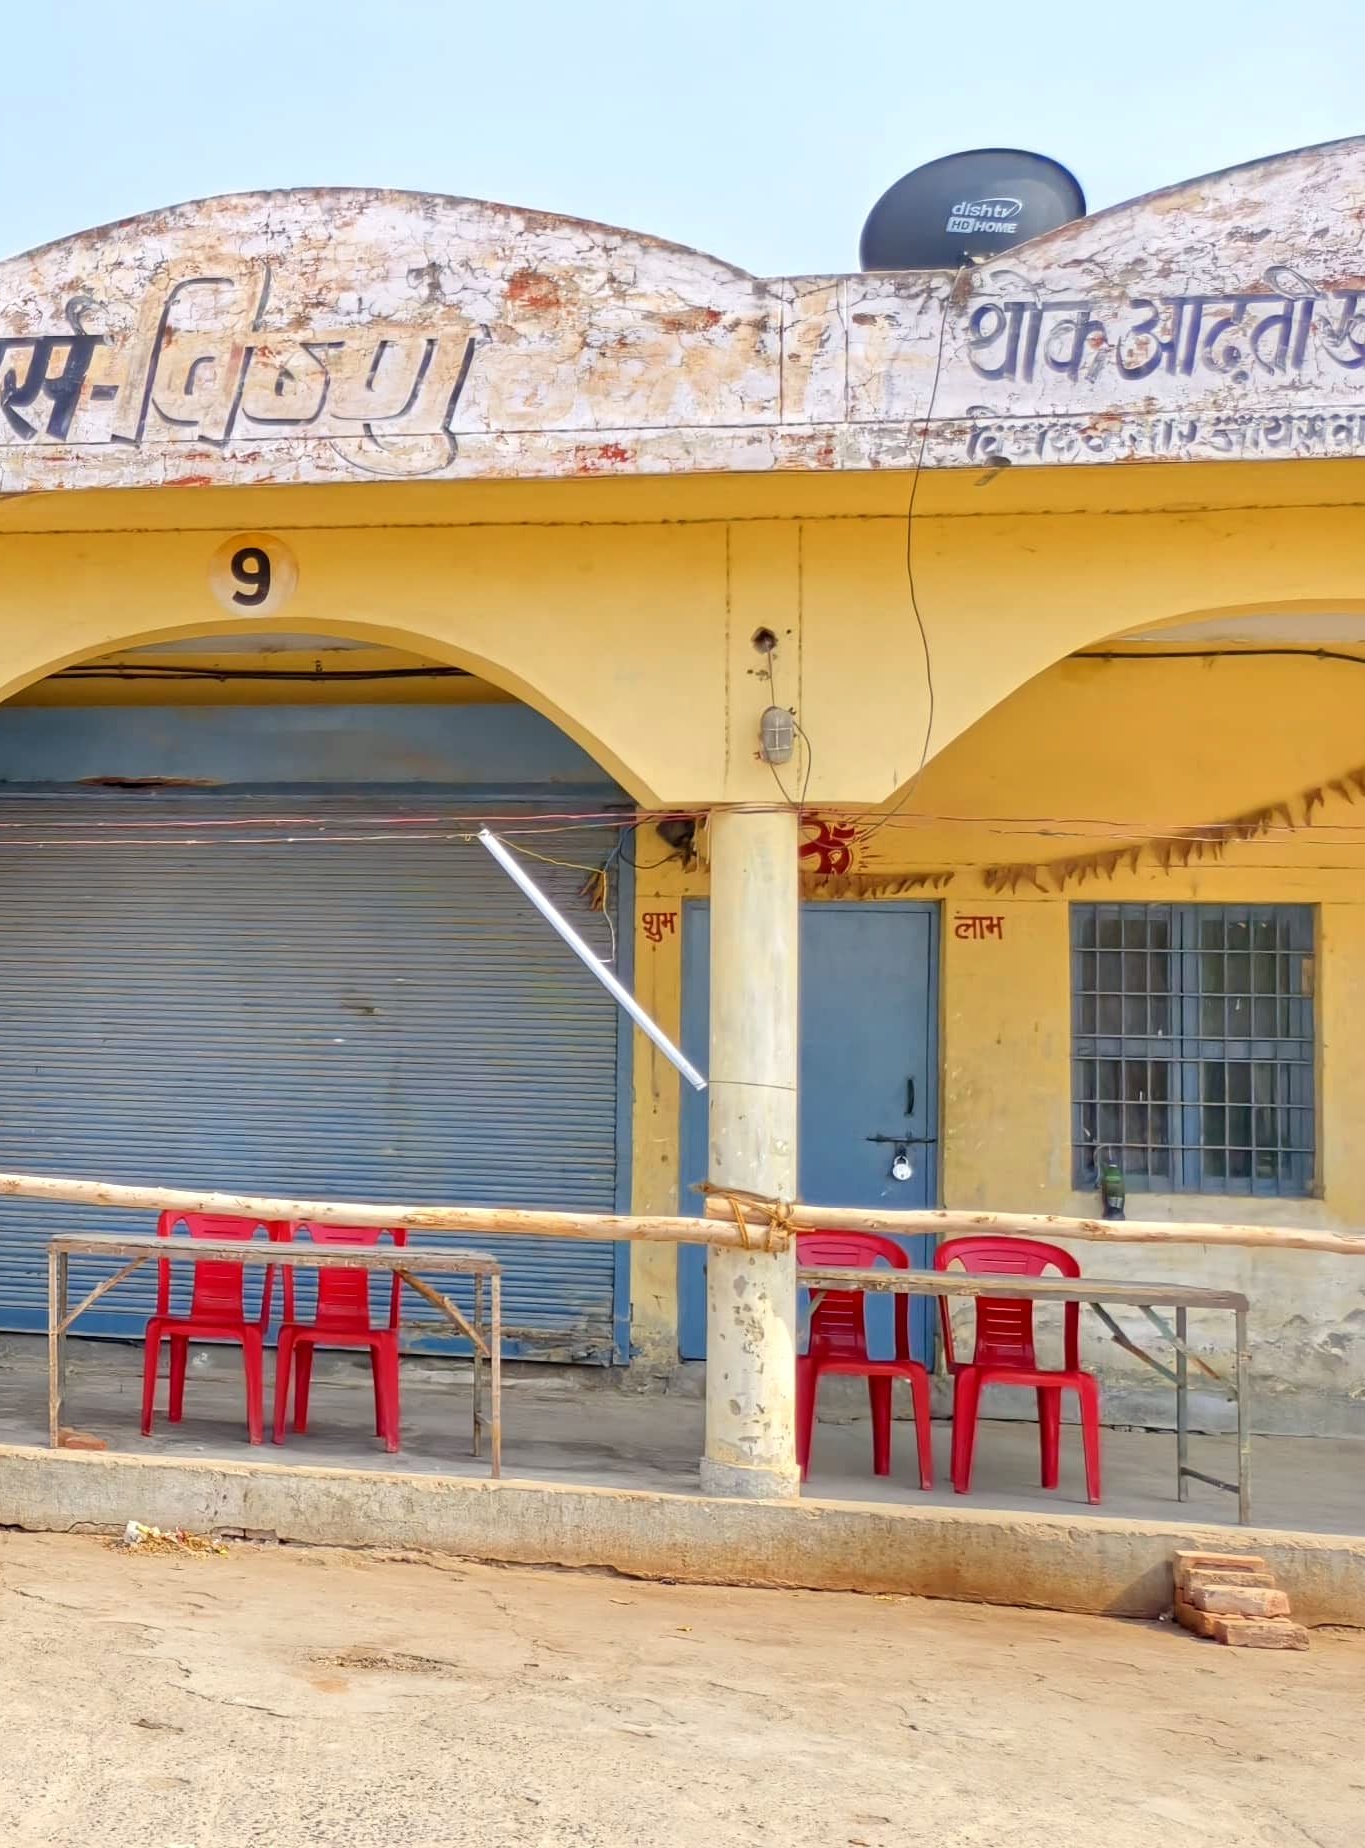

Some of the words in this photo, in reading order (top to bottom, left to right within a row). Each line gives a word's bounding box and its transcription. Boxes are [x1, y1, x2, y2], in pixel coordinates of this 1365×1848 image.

[951, 199, 1016, 218] dishtv
[948, 217, 973, 232] HD
[974, 221, 1018, 233] HOME
[231, 546, 271, 606] 9
[642, 911, 678, 943] शुभ
[954, 913, 1005, 942] लाभ
